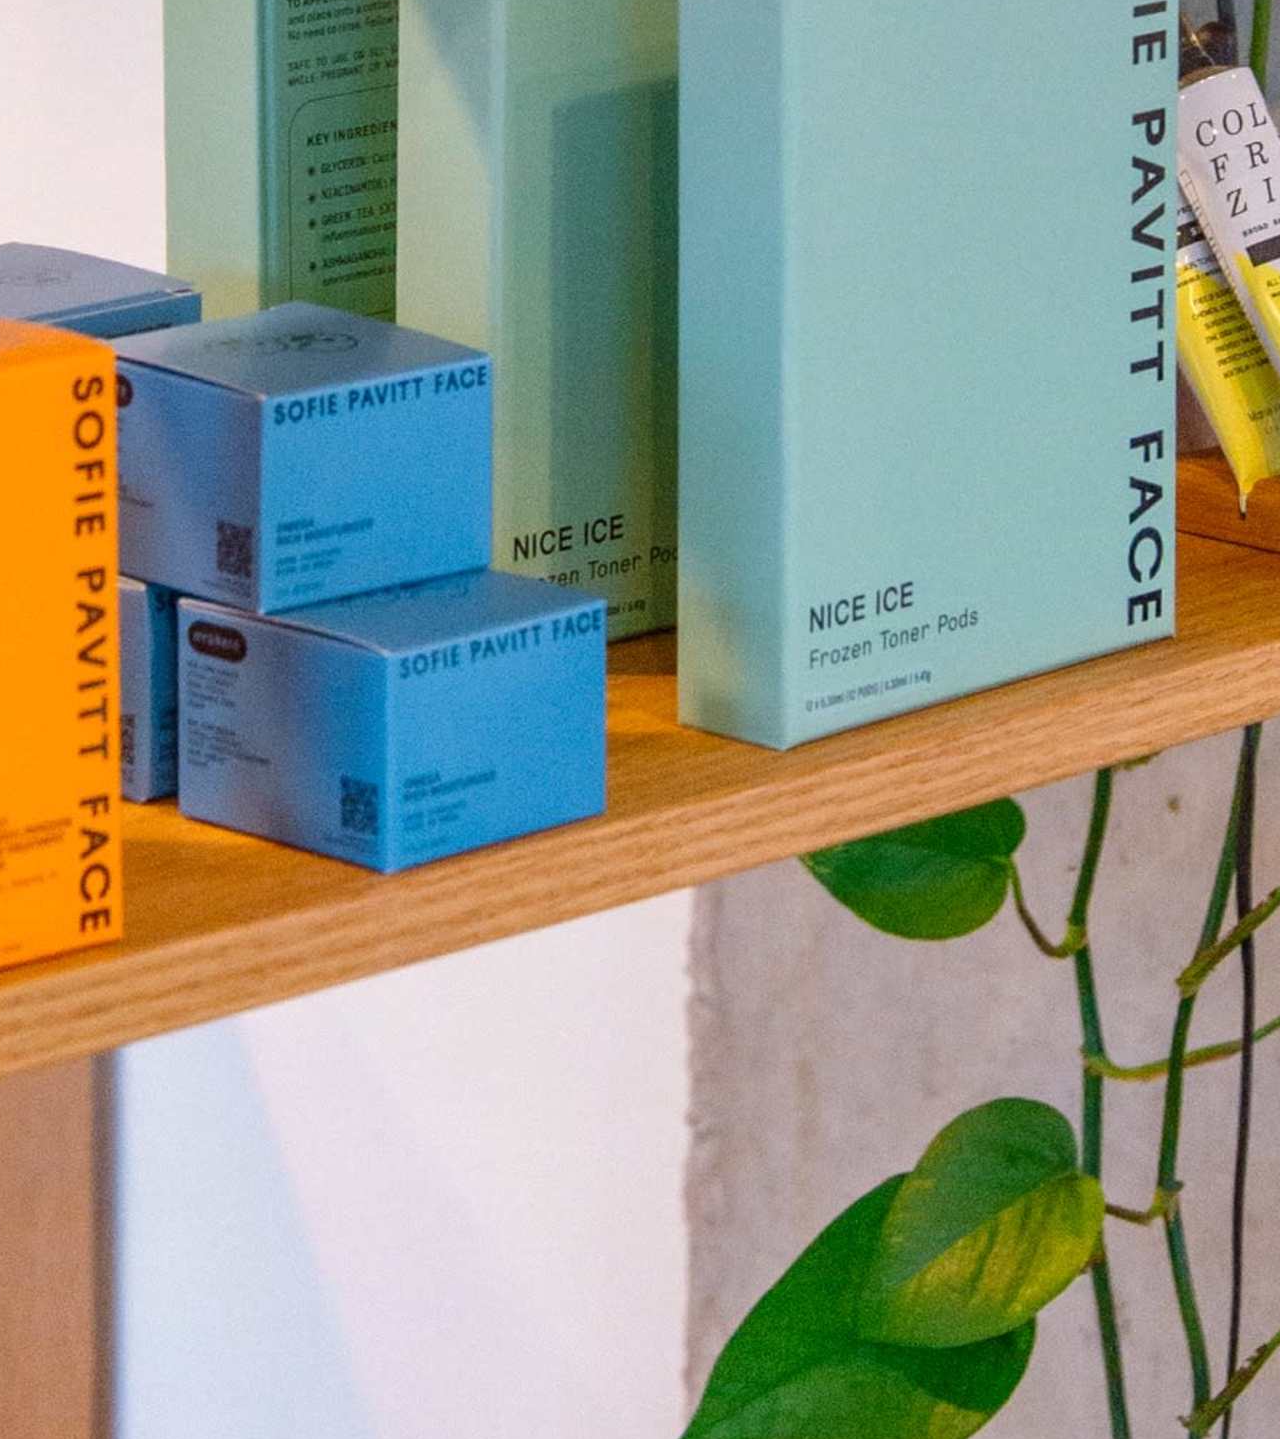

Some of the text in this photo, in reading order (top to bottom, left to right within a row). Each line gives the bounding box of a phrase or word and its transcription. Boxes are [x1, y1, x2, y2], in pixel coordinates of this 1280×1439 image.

[307, 121, 398, 146] KEY INGREDIEN
[1129, 108, 1166, 380] PAVITT
[273, 365, 488, 426] SOFIE PAVITT FACE
[513, 513, 625, 562] NICE ICE
[1127, 431, 1164, 626] FACE
[588, 553, 642, 580] Toner
[809, 580, 914, 634] NICE ICE
[71, 375, 111, 936] SOFIE PAVITT FACE
[398, 608, 603, 680] SOFIE PAVITT FACE
[809, 607, 979, 670] Frozen Toner Pods
